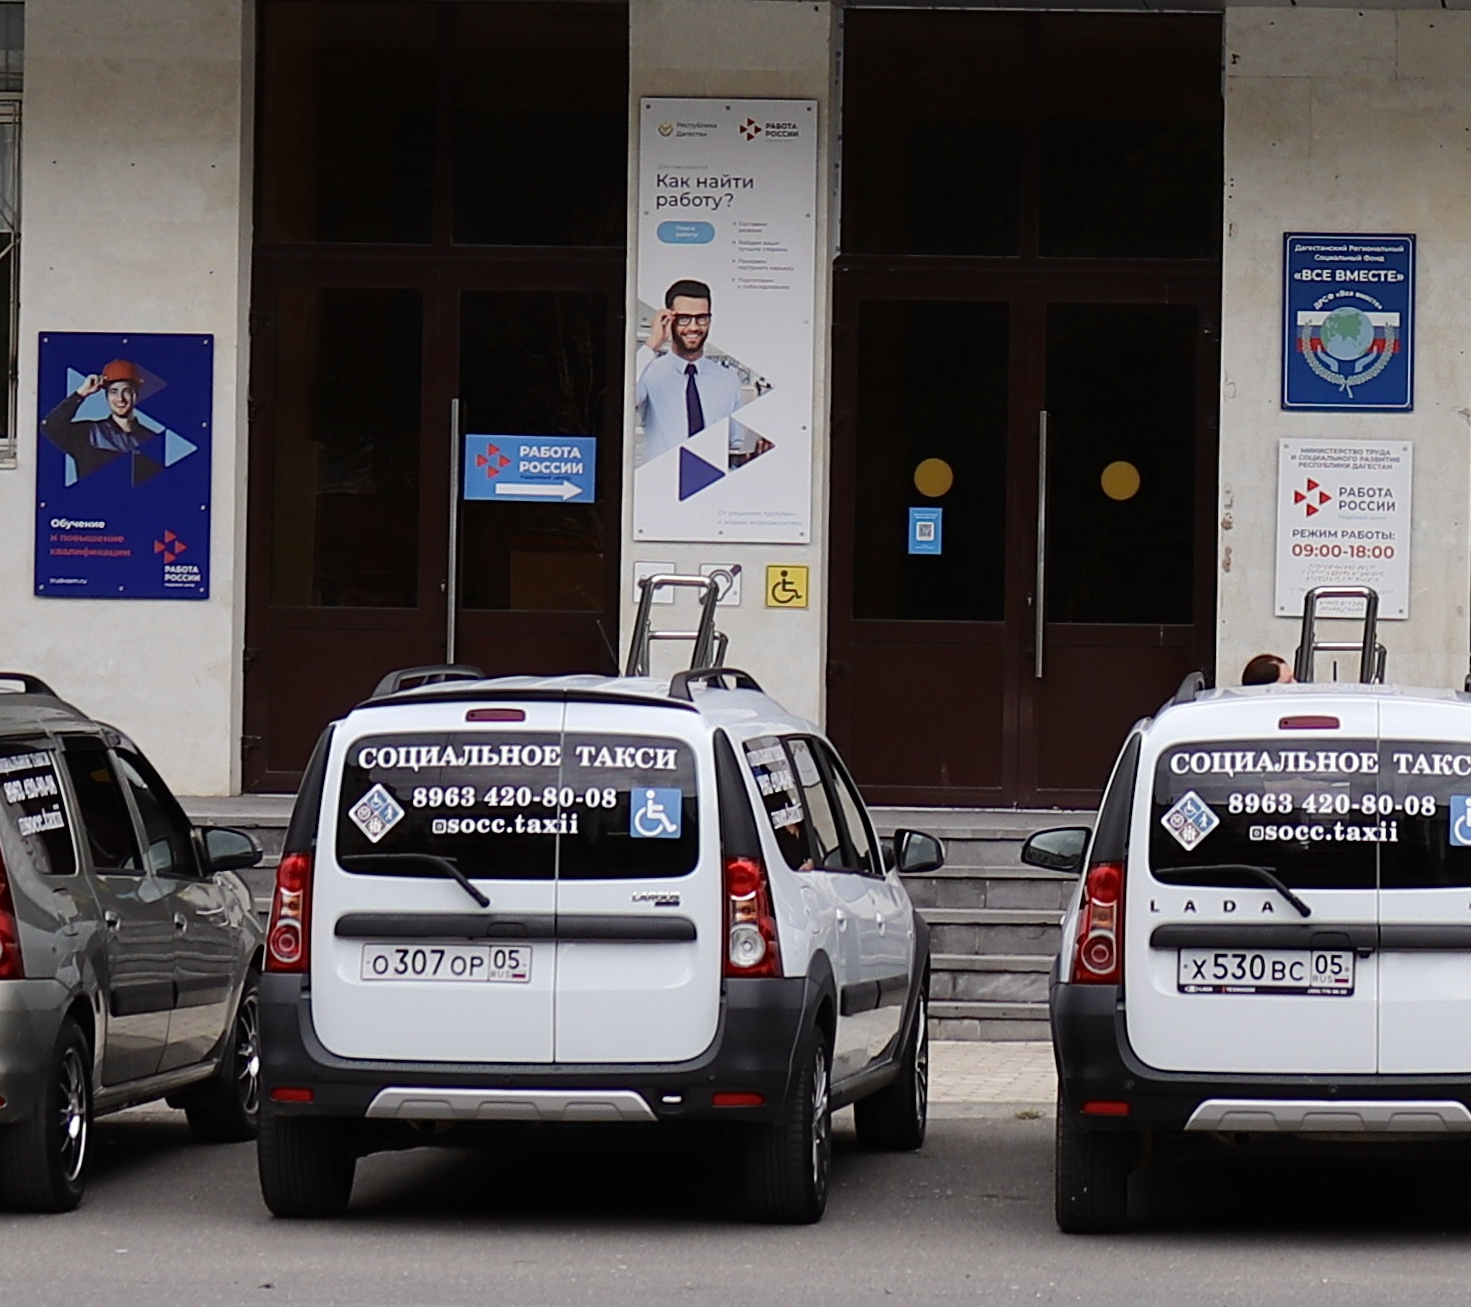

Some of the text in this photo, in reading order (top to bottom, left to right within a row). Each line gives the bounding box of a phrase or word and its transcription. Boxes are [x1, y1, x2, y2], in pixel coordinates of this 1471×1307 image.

[765, 122, 798, 130] РАБОТА
[656, 173, 754, 190] Как найти
[656, 192, 734, 210] работу?
[1294, 244, 1405, 253] Дагестанский Региональный
[1314, 253, 1385, 262] Социальный Фонд
[1294, 269, 1405, 282] «ВСЕ ВМЕСТЕ»
[519, 445, 582, 459] РАБОТА
[519, 461, 584, 474] РОССИИ
[1338, 486, 1394, 498] РАБОТА
[1338, 500, 1396, 512] РОССИИ
[50, 518, 106, 529] Обучение
[1292, 528, 1396, 540] РЕЖИМ РАБОТЫ:
[1291, 543, 1396, 559] 09:00-18:00
[164, 565, 200, 574] РАБОТА
[164, 574, 201, 582] РОССИИ
[358, 744, 678, 772] СОЦИАЛЬНОЕ ТАКСИ
[1169, 750, 1380, 779] СОЦИАЛЬНОЕ
[411, 785, 617, 809] 8963 420-80-08
[1228, 792, 1436, 816] 8963 420-80-08
[1149, 899, 1275, 914] LADA
[492, 948, 521, 970] 05
[1314, 953, 1344, 976] 05
